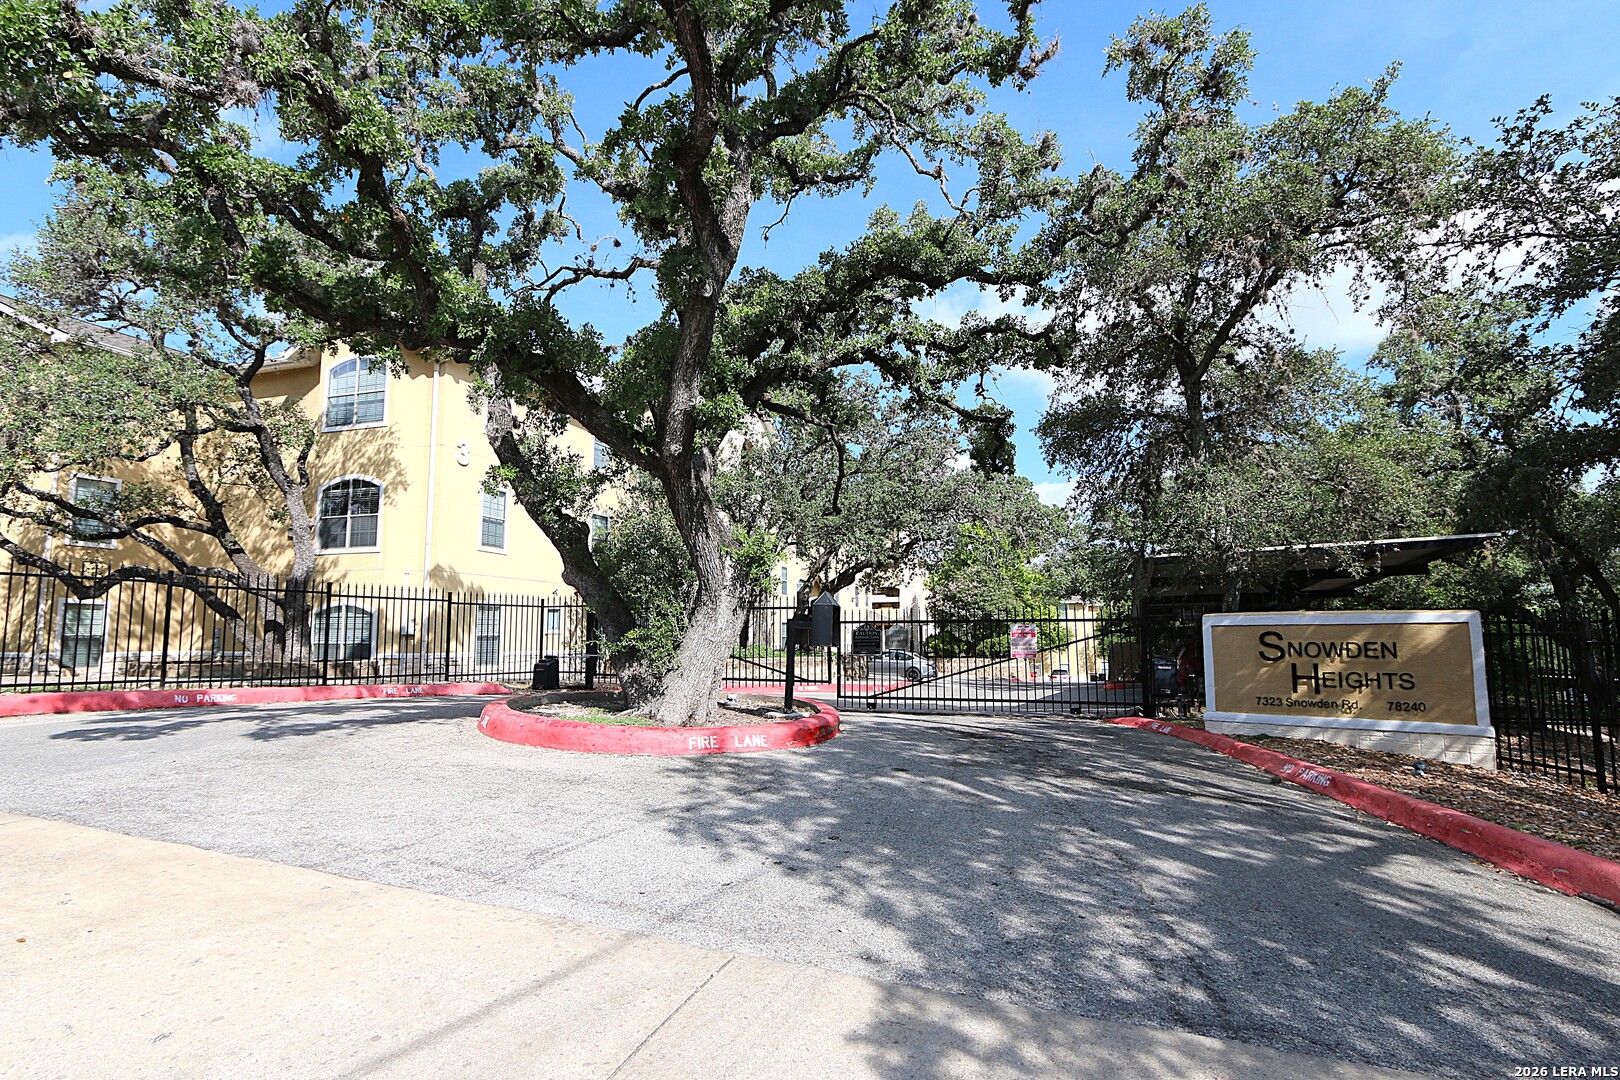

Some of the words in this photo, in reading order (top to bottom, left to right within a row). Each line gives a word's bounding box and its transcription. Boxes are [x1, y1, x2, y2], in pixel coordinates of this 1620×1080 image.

[1259, 631, 1397, 661] SNOWDEN
[1291, 663, 1415, 694] HEIGHTS
[383, 687, 399, 695] FIRE
[405, 686, 423, 694] LANE
[174, 694, 189, 703] NO
[196, 694, 237, 703] PARKING
[1256, 697, 1283, 707] 7323
[1286, 698, 1338, 709] Snowden
[1341, 700, 1362, 709] Rd.
[1387, 702, 1426, 712] 78240
[688, 735, 719, 749] FIRE
[734, 735, 769, 747] LANE
[1280, 763, 1295, 773] NO
[1295, 767, 1332, 787] PARKING
